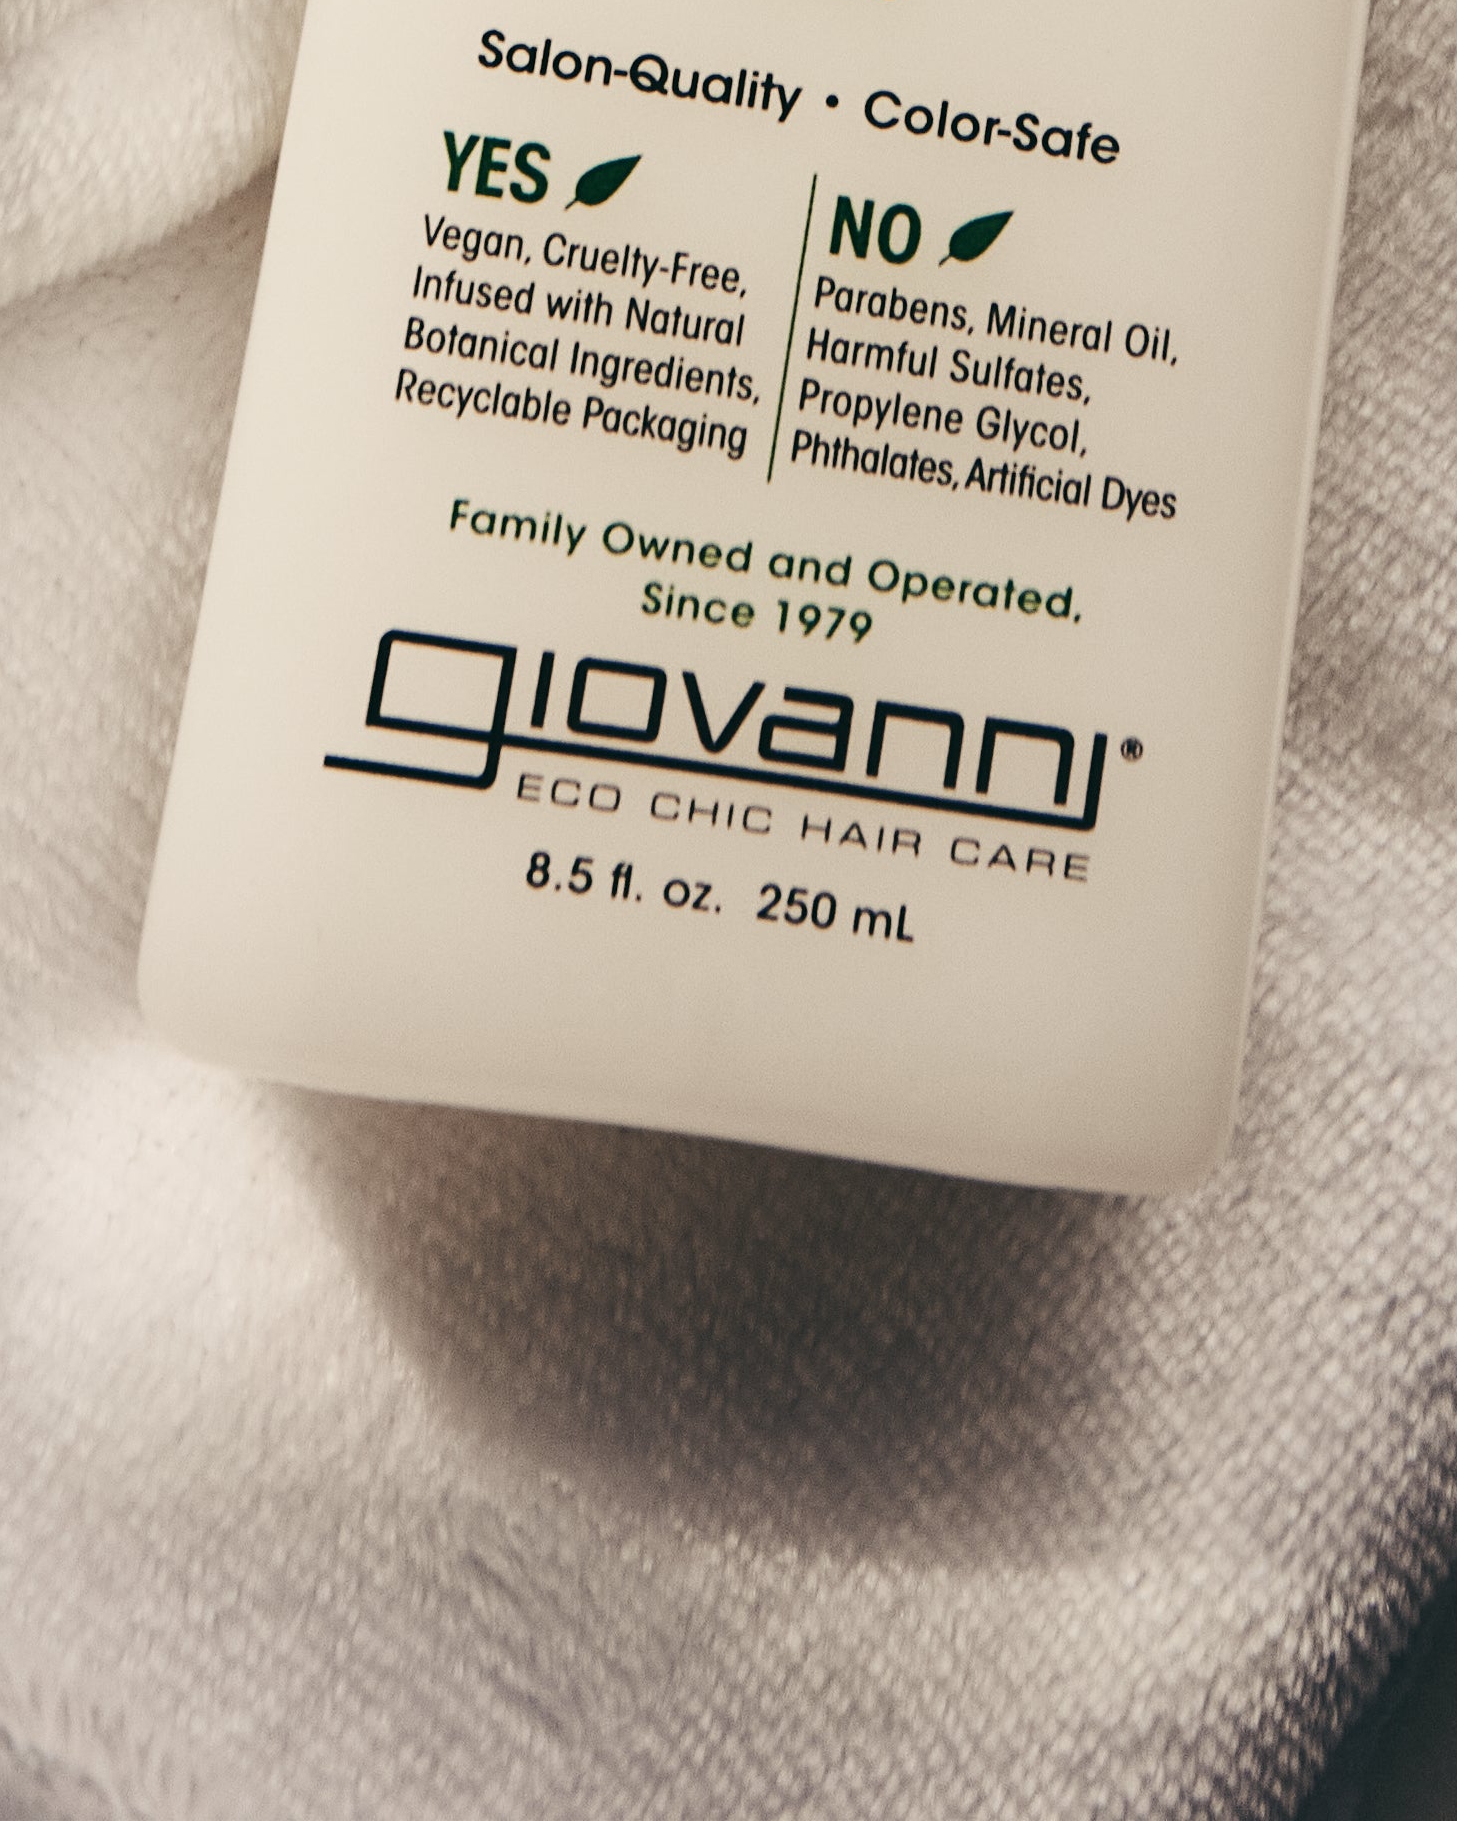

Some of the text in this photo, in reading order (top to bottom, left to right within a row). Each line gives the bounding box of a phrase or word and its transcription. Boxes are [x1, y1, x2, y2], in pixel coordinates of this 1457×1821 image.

[477, 28, 1121, 166] Salon-Quality Color-Safe
[442, 129, 552, 206] YES
[423, 212, 747, 300] Vegan, Cruelty-Free,
[828, 194, 923, 267] NO
[412, 264, 746, 348] Infused with Natural
[813, 274, 1178, 368] Parabens, Mineral Oil,
[403, 315, 760, 407] Botanical Ingredients,
[805, 325, 1091, 407] Harmful Sulfates,
[394, 366, 748, 462] Recyclable Packaging
[798, 376, 1087, 459] Propylene Glycol,
[790, 427, 1178, 524] Phthalates, Artificial Dyes
[449, 497, 1082, 625] Family Owned and Operated,
[640, 580, 874, 646] Since 1979
[516, 772, 1091, 883] ECO CHIC HAIR CARE
[525, 849, 915, 944] 8.5 fl. oz. 250 mL
